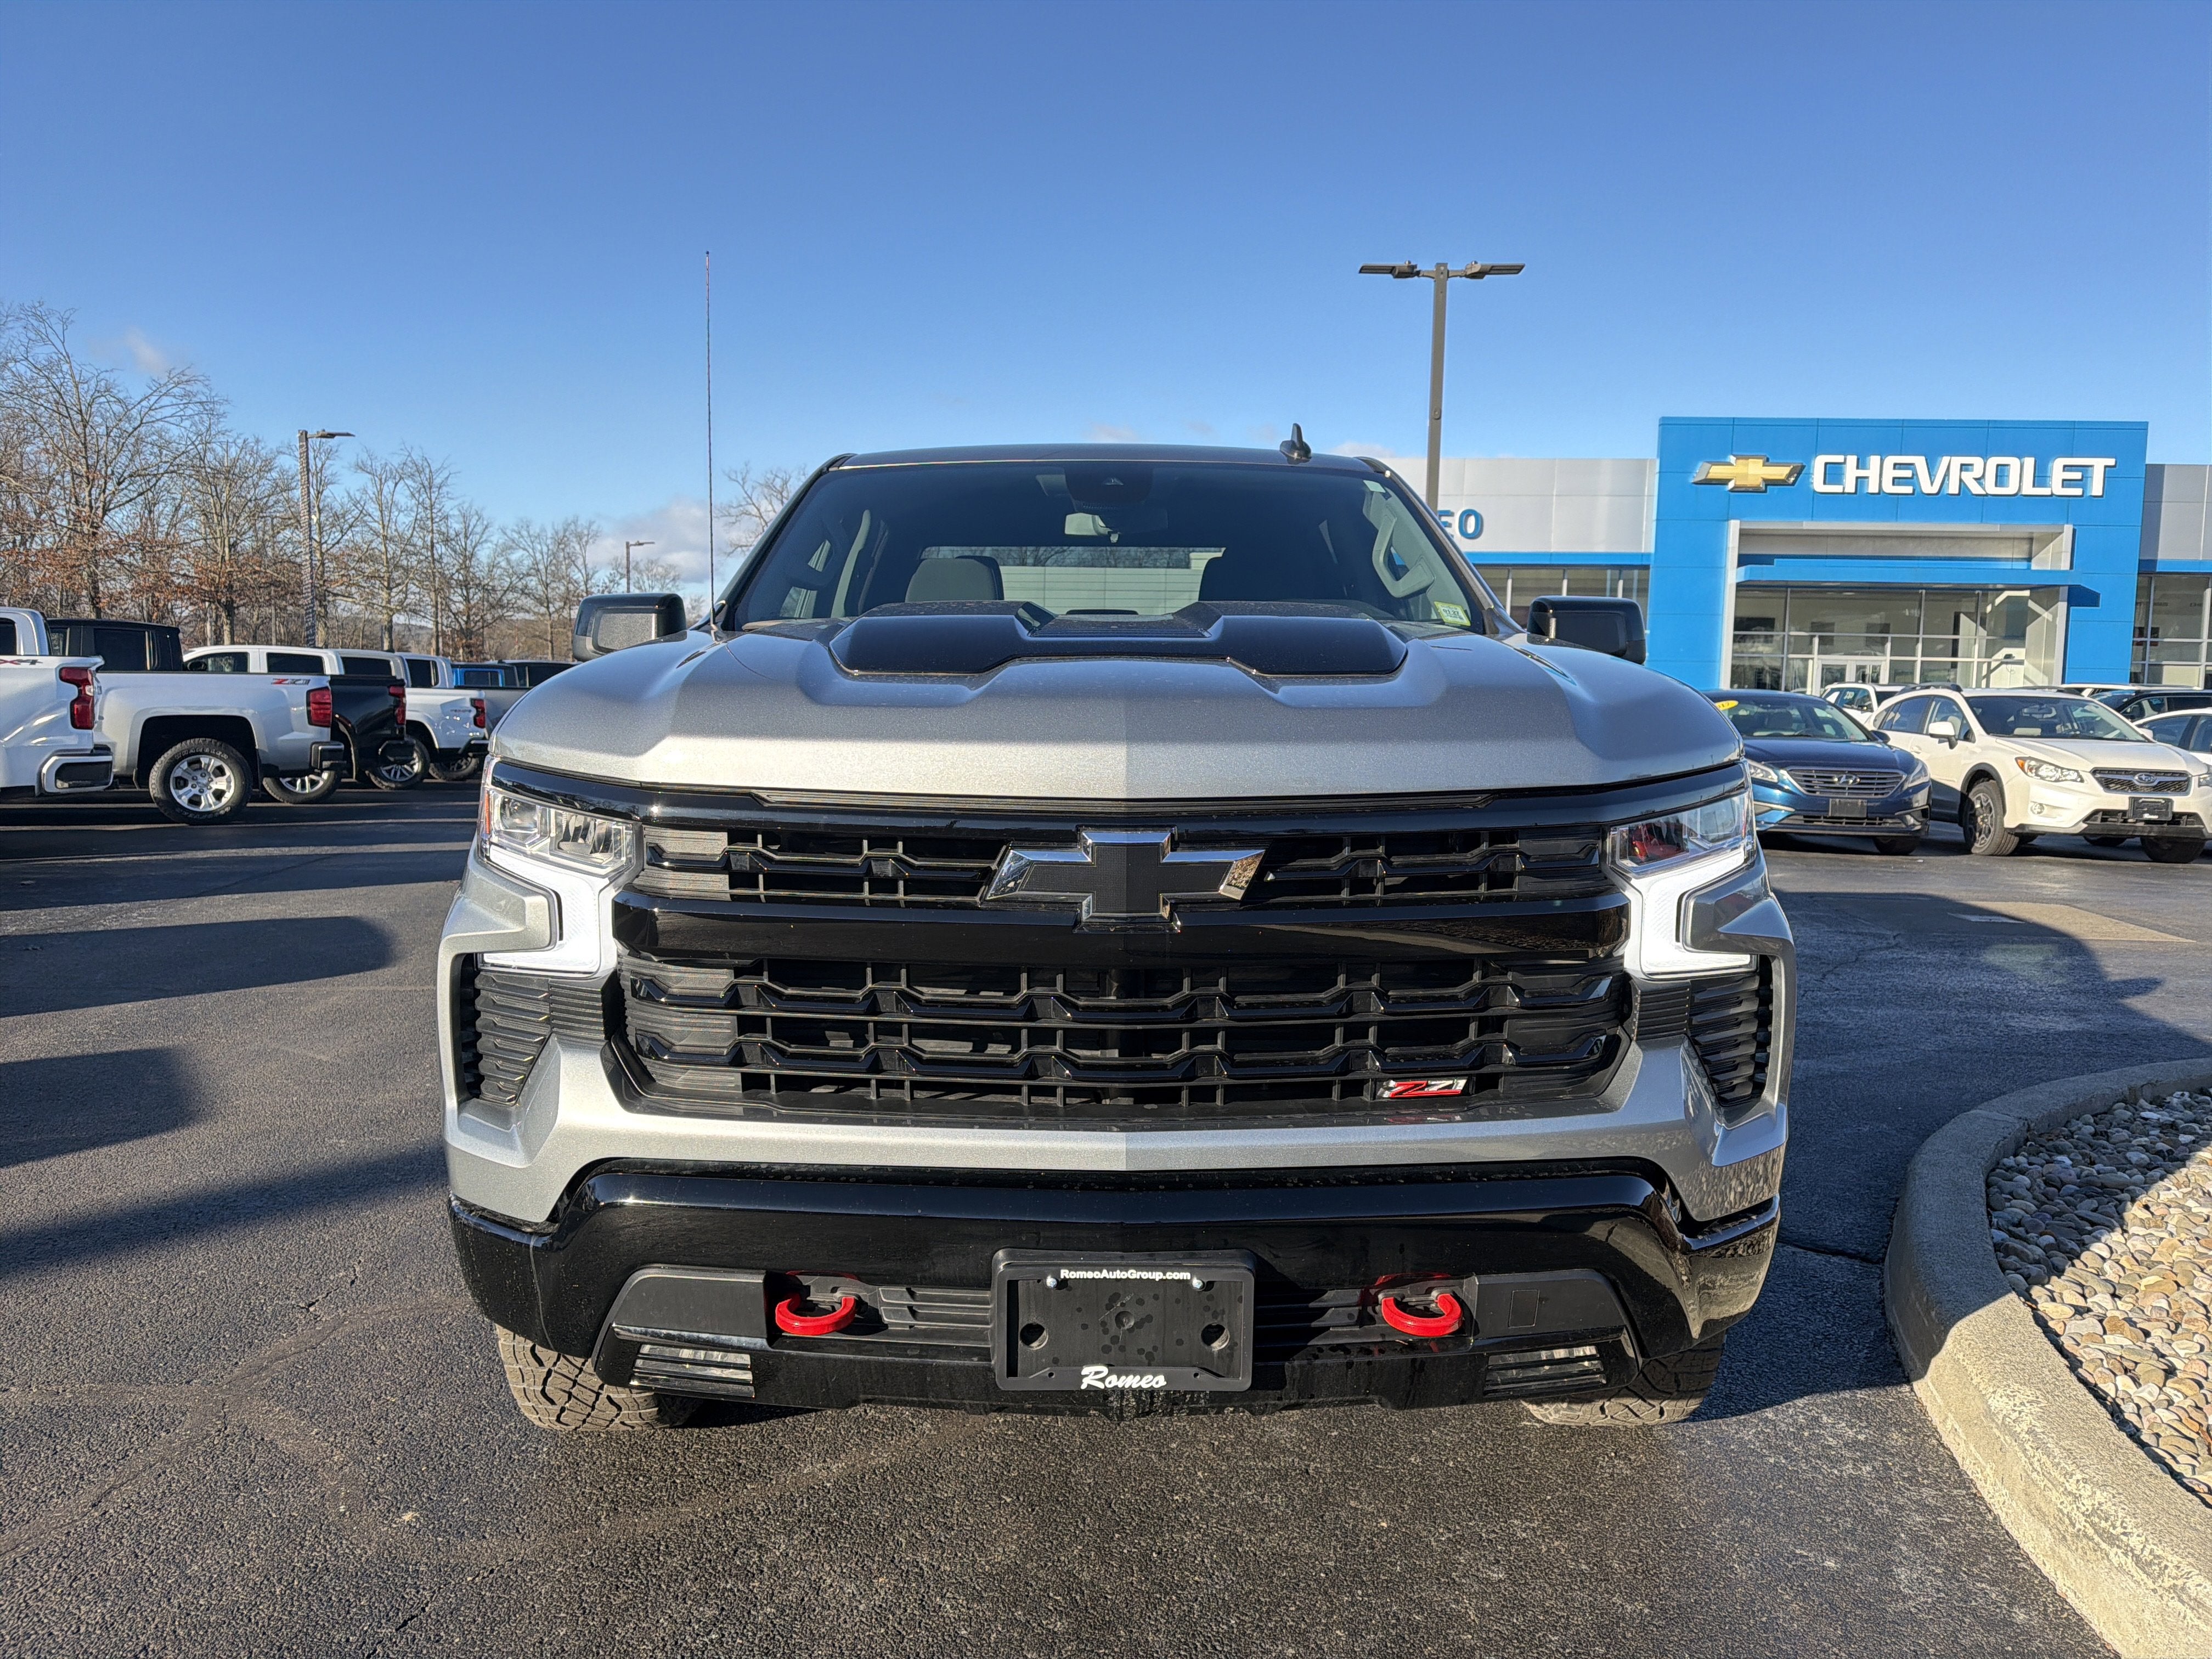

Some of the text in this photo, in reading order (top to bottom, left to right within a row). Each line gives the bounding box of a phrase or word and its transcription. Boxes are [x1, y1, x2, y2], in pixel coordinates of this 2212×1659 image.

[1813, 454, 2116, 497] CHEVROLET
[1378, 1077, 1468, 1099] Z71
[1060, 1269, 1191, 1281] RomeoAutoGroup.com
[1080, 1365, 1167, 1390] Romeo
